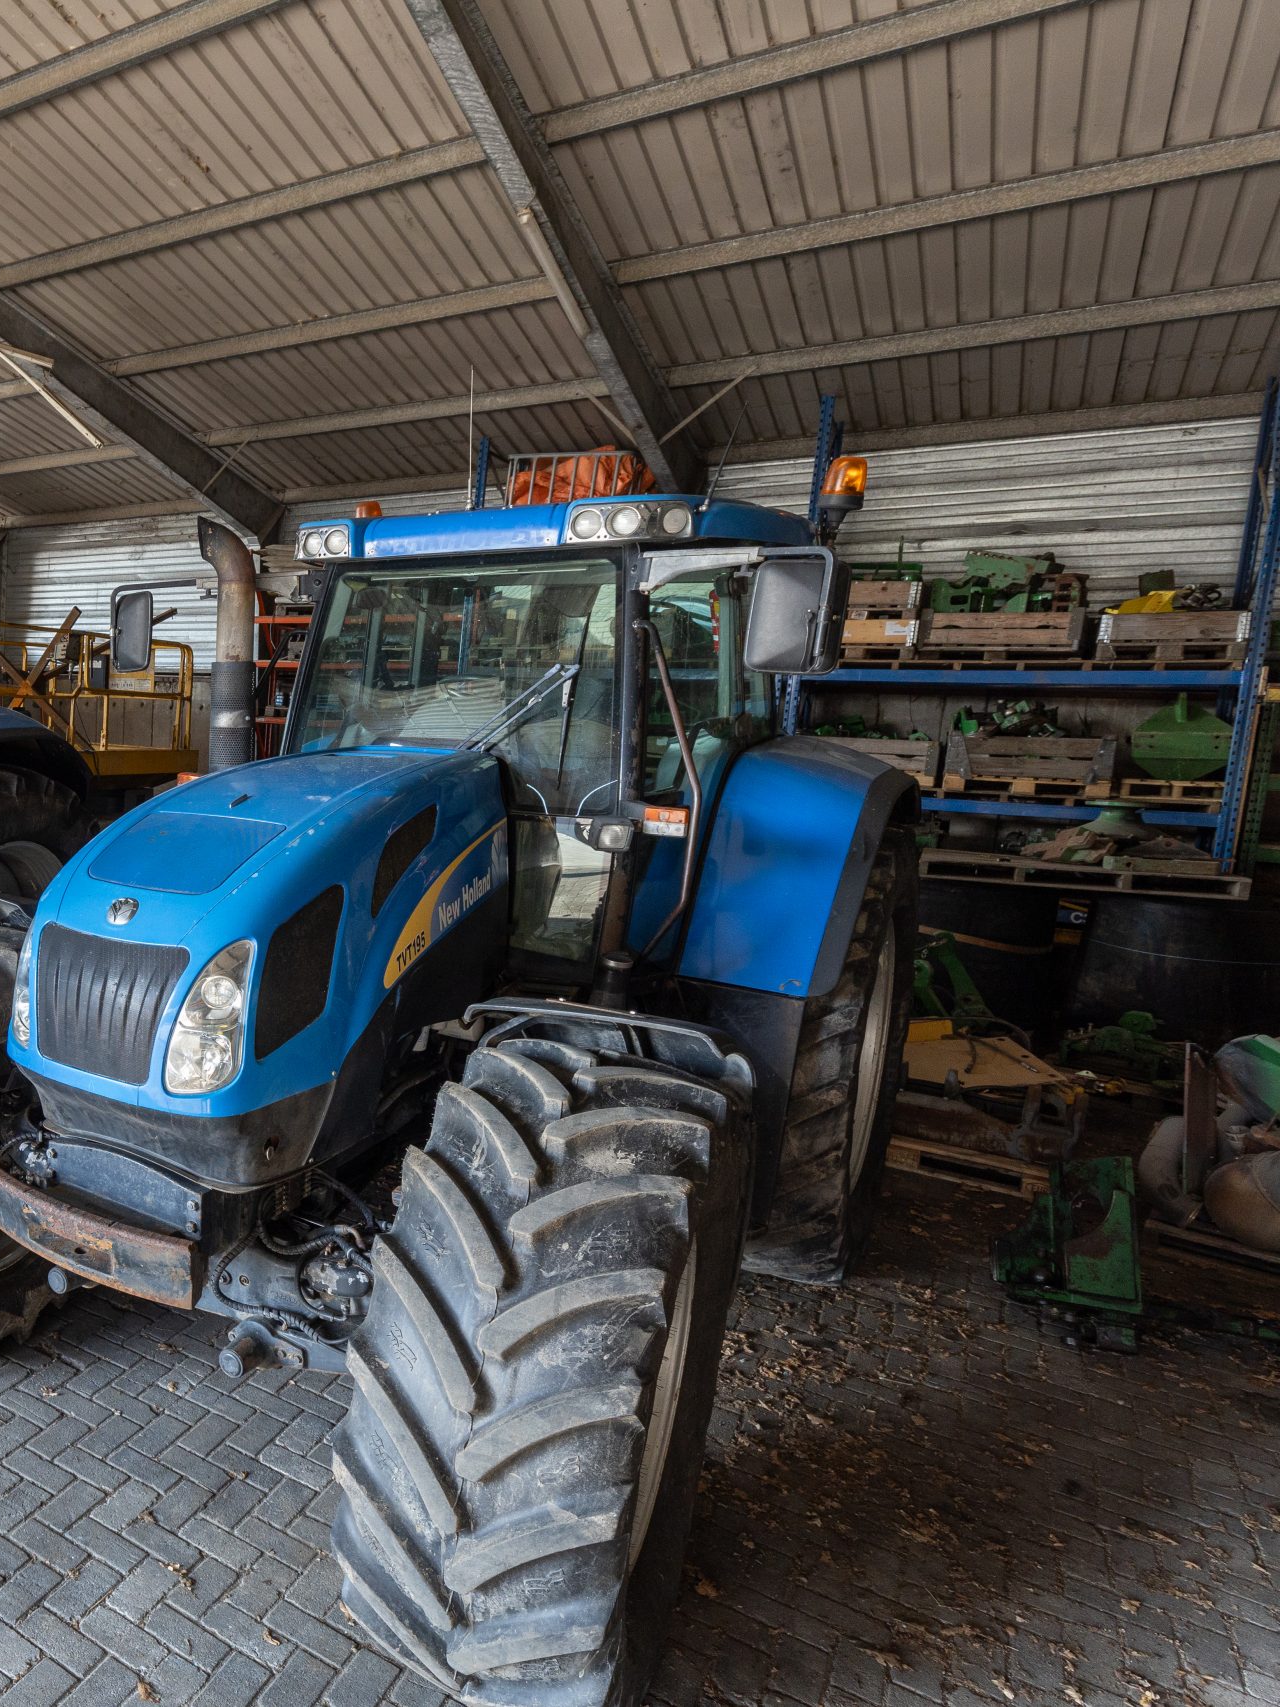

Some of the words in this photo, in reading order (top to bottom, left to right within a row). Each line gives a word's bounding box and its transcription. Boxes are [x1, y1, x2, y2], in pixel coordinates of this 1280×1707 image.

[438, 897, 460, 932] New
[462, 867, 491, 912] Holland
[395, 931, 426, 972] TVT195
